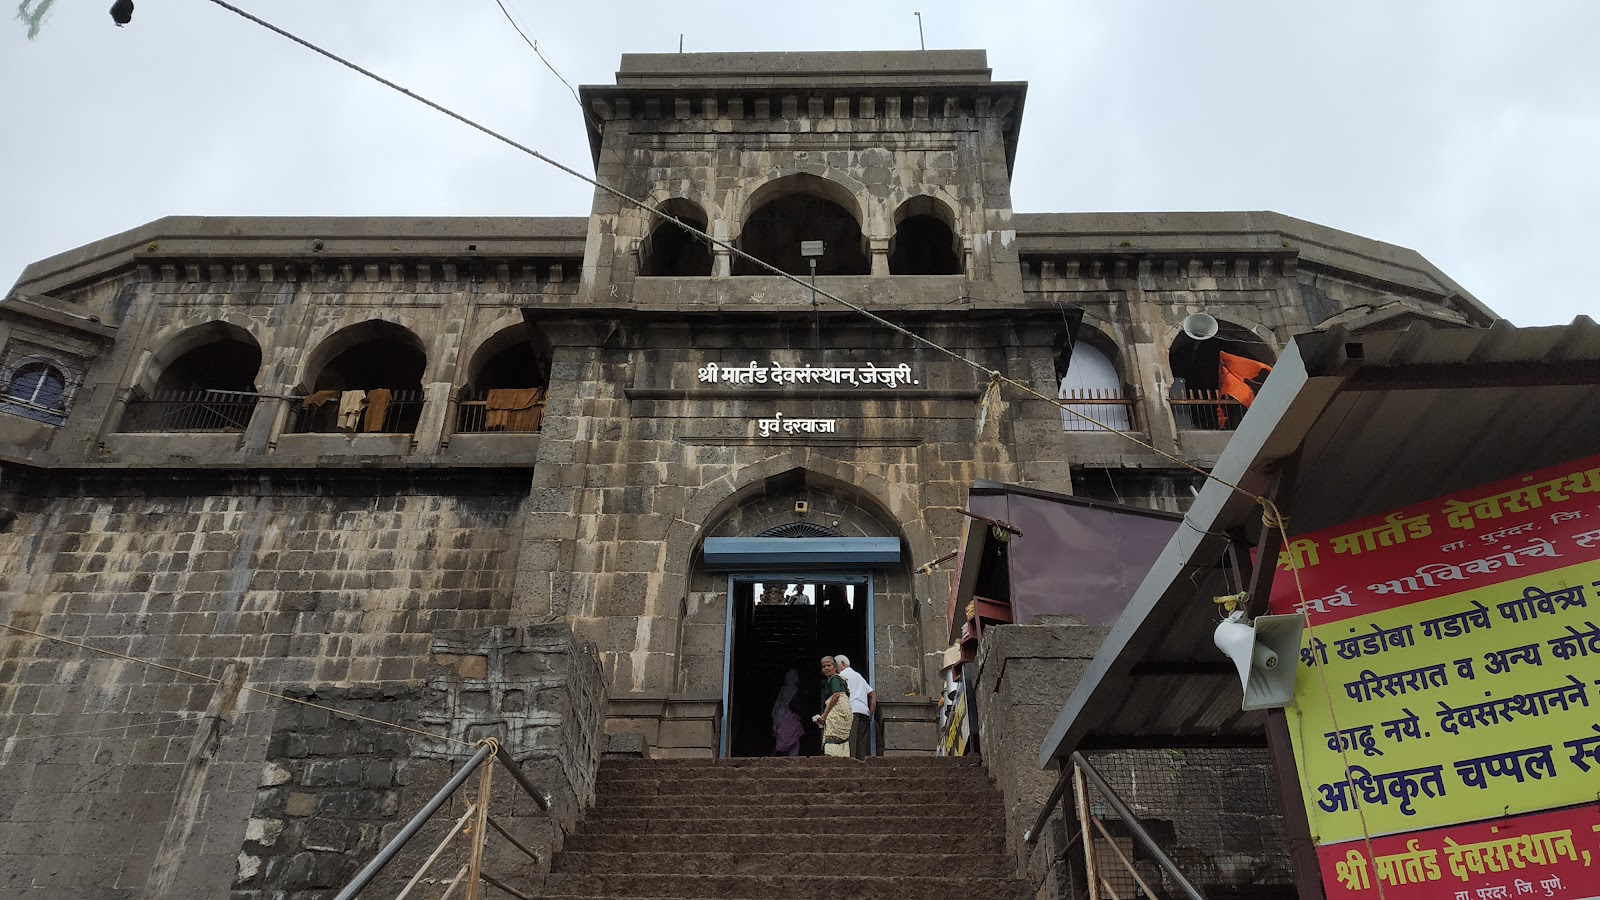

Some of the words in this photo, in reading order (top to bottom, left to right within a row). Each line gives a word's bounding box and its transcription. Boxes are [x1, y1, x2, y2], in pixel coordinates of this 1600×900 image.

[698, 362, 718, 383] श्री
[721, 361, 769, 383] मार्तंड
[759, 412, 782, 437] पुर्व
[783, 419, 835, 434] दरवाजा
[1276, 539, 1320, 571] श्री
[1330, 512, 1433, 555] मार्तंड
[1442, 467, 1600, 530] देवसंस्थ
[1479, 522, 1542, 546] पुरंदर,
[1550, 510, 1589, 525] जि.
[1292, 585, 1358, 615] सर्व
[1367, 538, 1564, 594] भाविकांचे
[1300, 637, 1328, 668] श्री
[1334, 623, 1415, 661] खंडोबा
[1420, 600, 1492, 640] गडाचे
[1497, 585, 1588, 623] पावित्र्य
[1344, 663, 1448, 703] परिसरात
[1453, 657, 1475, 681] व
[1484, 643, 1543, 676] अन्य
[1324, 723, 1384, 757] काढू
[1381, 707, 1430, 743] नये.
[1437, 674, 1589, 736] देवसंस्थानने
[1317, 764, 1446, 816] अधिकृत
[1454, 744, 1557, 790] चप्पल
[1335, 849, 1370, 891] श्री
[1376, 839, 1441, 887] मार्तंड
[1443, 826, 1591, 882] देवसंस्थान,
[1514, 878, 1538, 896] जि.
[1540, 874, 1567, 897] पुणे.
